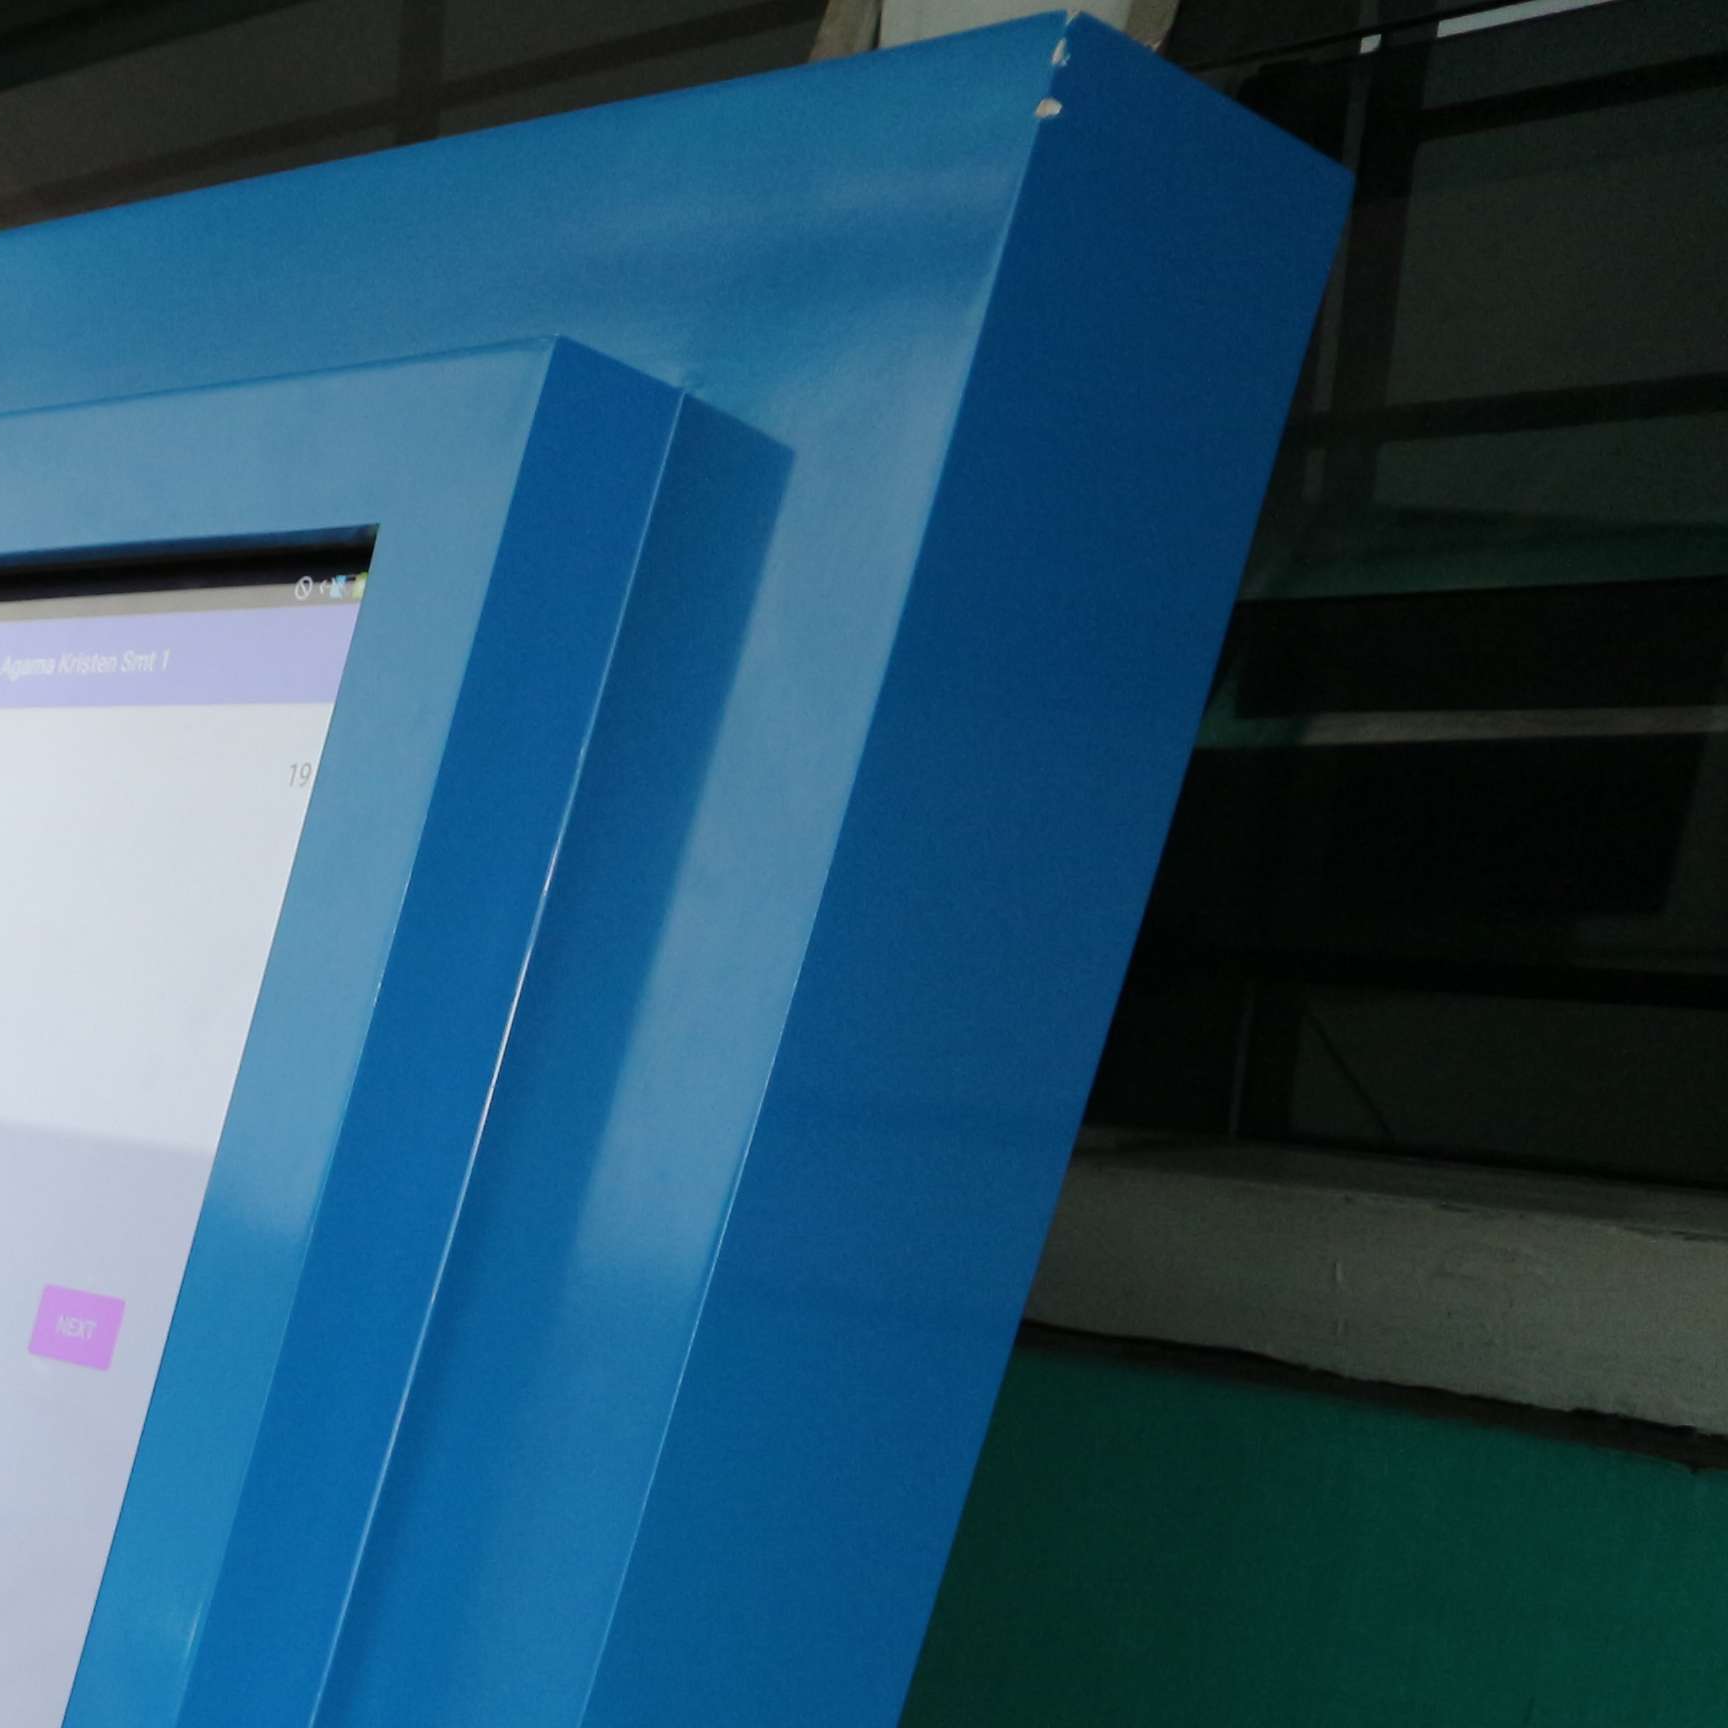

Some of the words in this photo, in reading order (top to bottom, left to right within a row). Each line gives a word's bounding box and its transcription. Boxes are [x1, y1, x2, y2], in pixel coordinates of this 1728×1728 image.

[0, 654, 56, 682] Agama
[57, 650, 118, 675] Kristen
[287, 761, 312, 788] 19
[56, 1312, 97, 1341] NEXT
